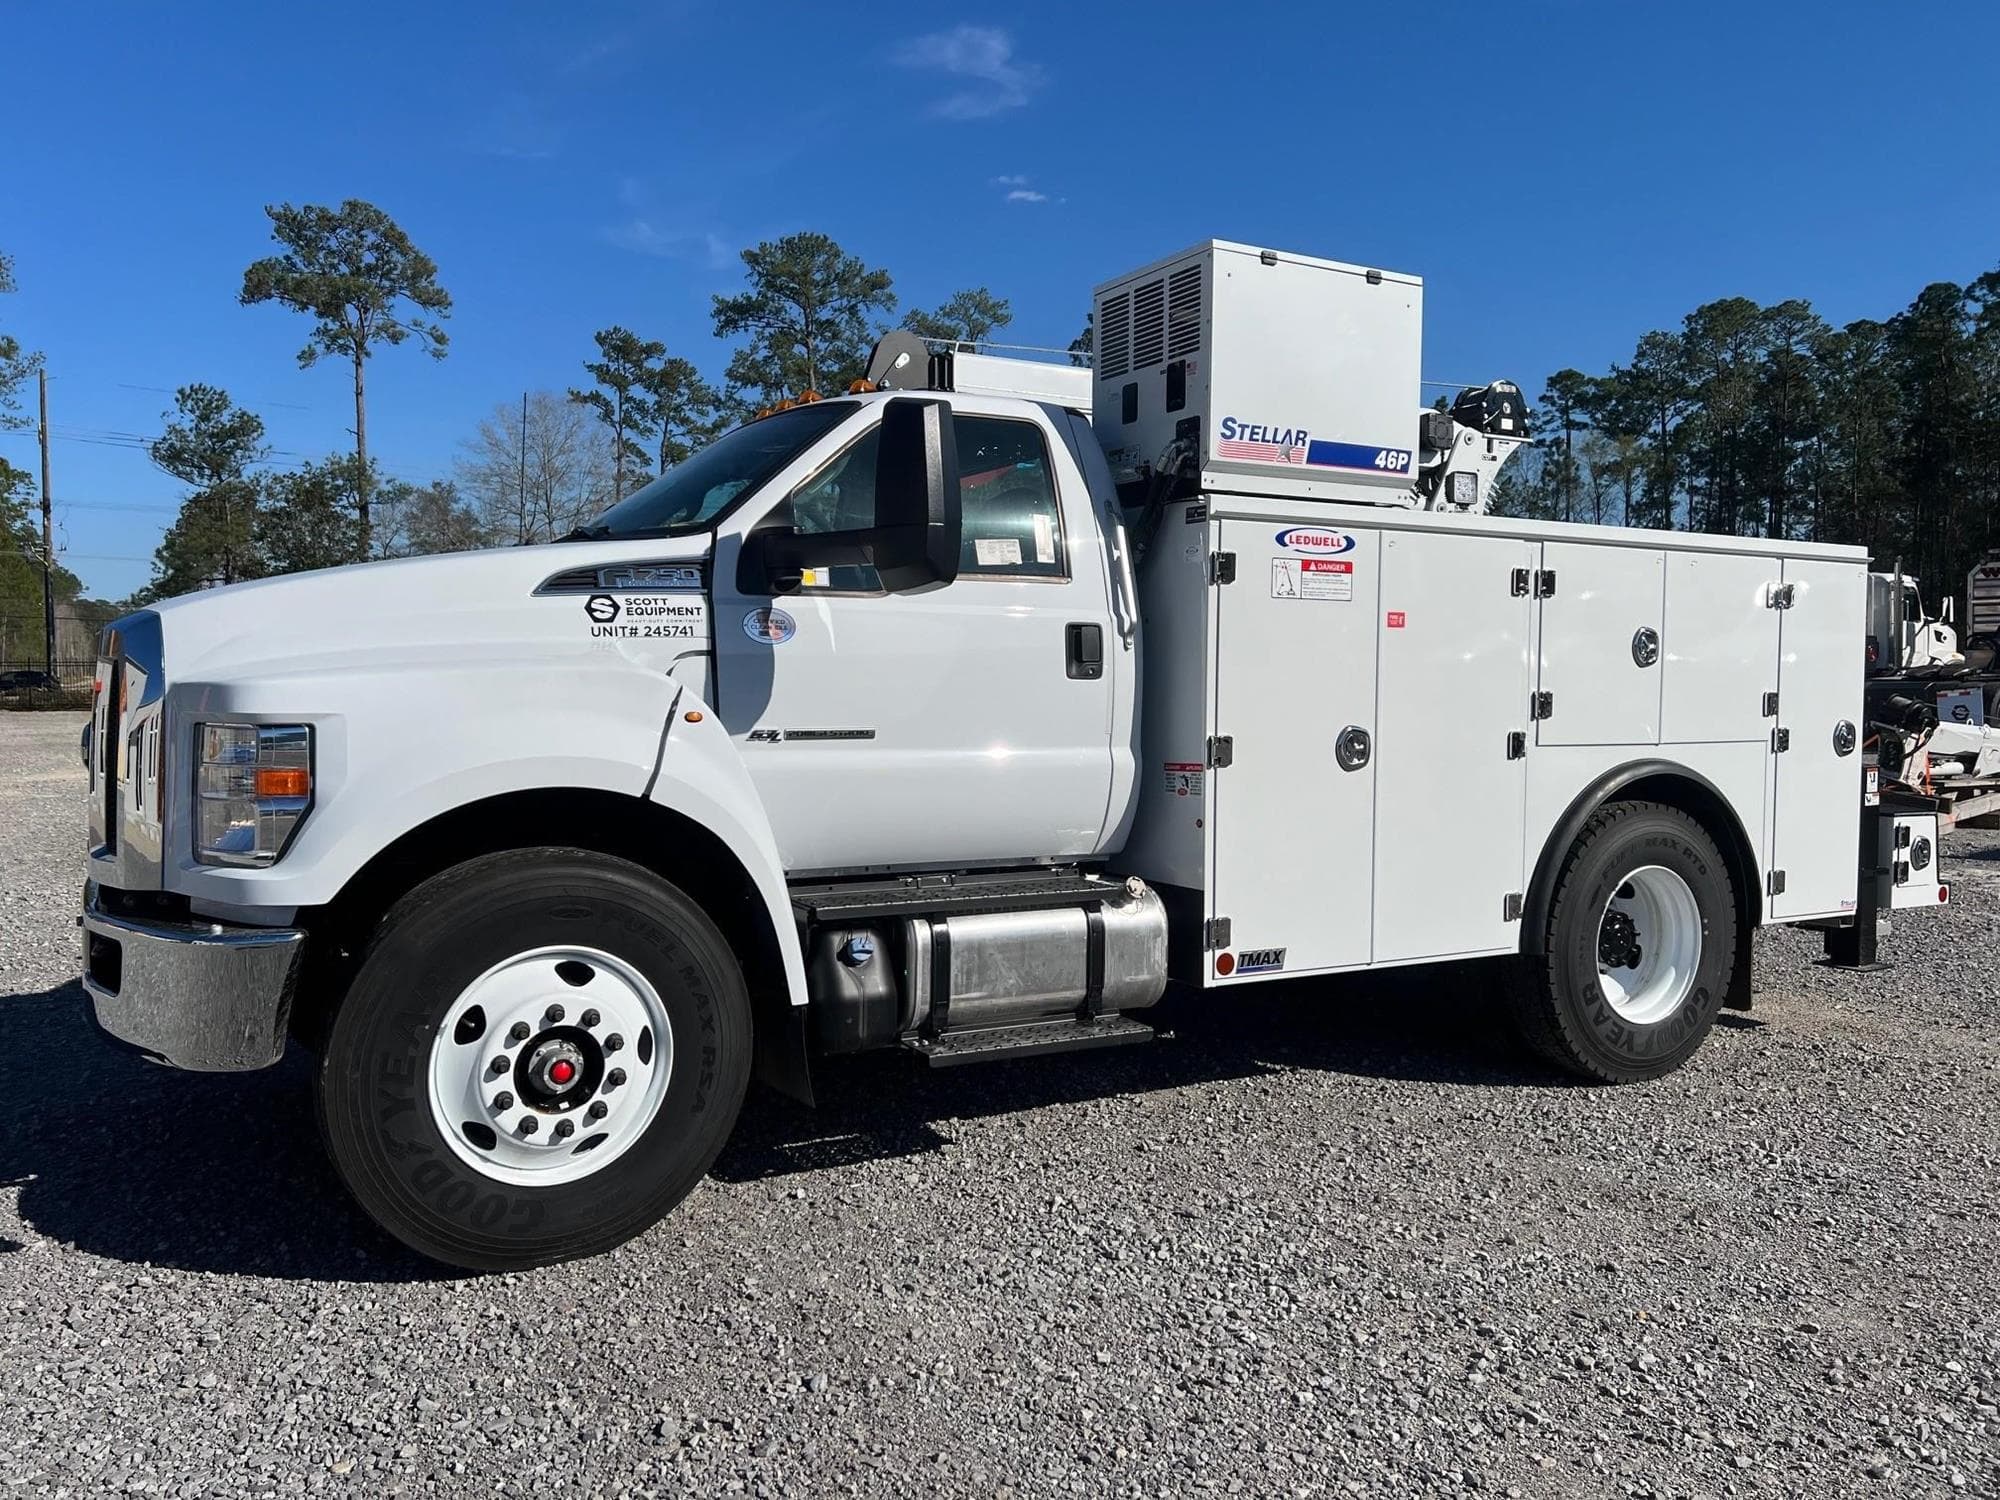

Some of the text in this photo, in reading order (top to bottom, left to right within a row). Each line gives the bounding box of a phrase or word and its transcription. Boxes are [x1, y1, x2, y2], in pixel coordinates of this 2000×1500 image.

[1220, 417, 1307, 447] STELLAR
[1374, 450, 1409, 470] 46P
[1289, 535, 1343, 547] LEDWELL
[1317, 563, 1346, 571] DANGER
[624, 598, 668, 606] SCOTT
[626, 607, 703, 616] EQUIPMENT
[591, 626, 695, 637] UNIT# 245741
[1239, 951, 1283, 967] TMAX
